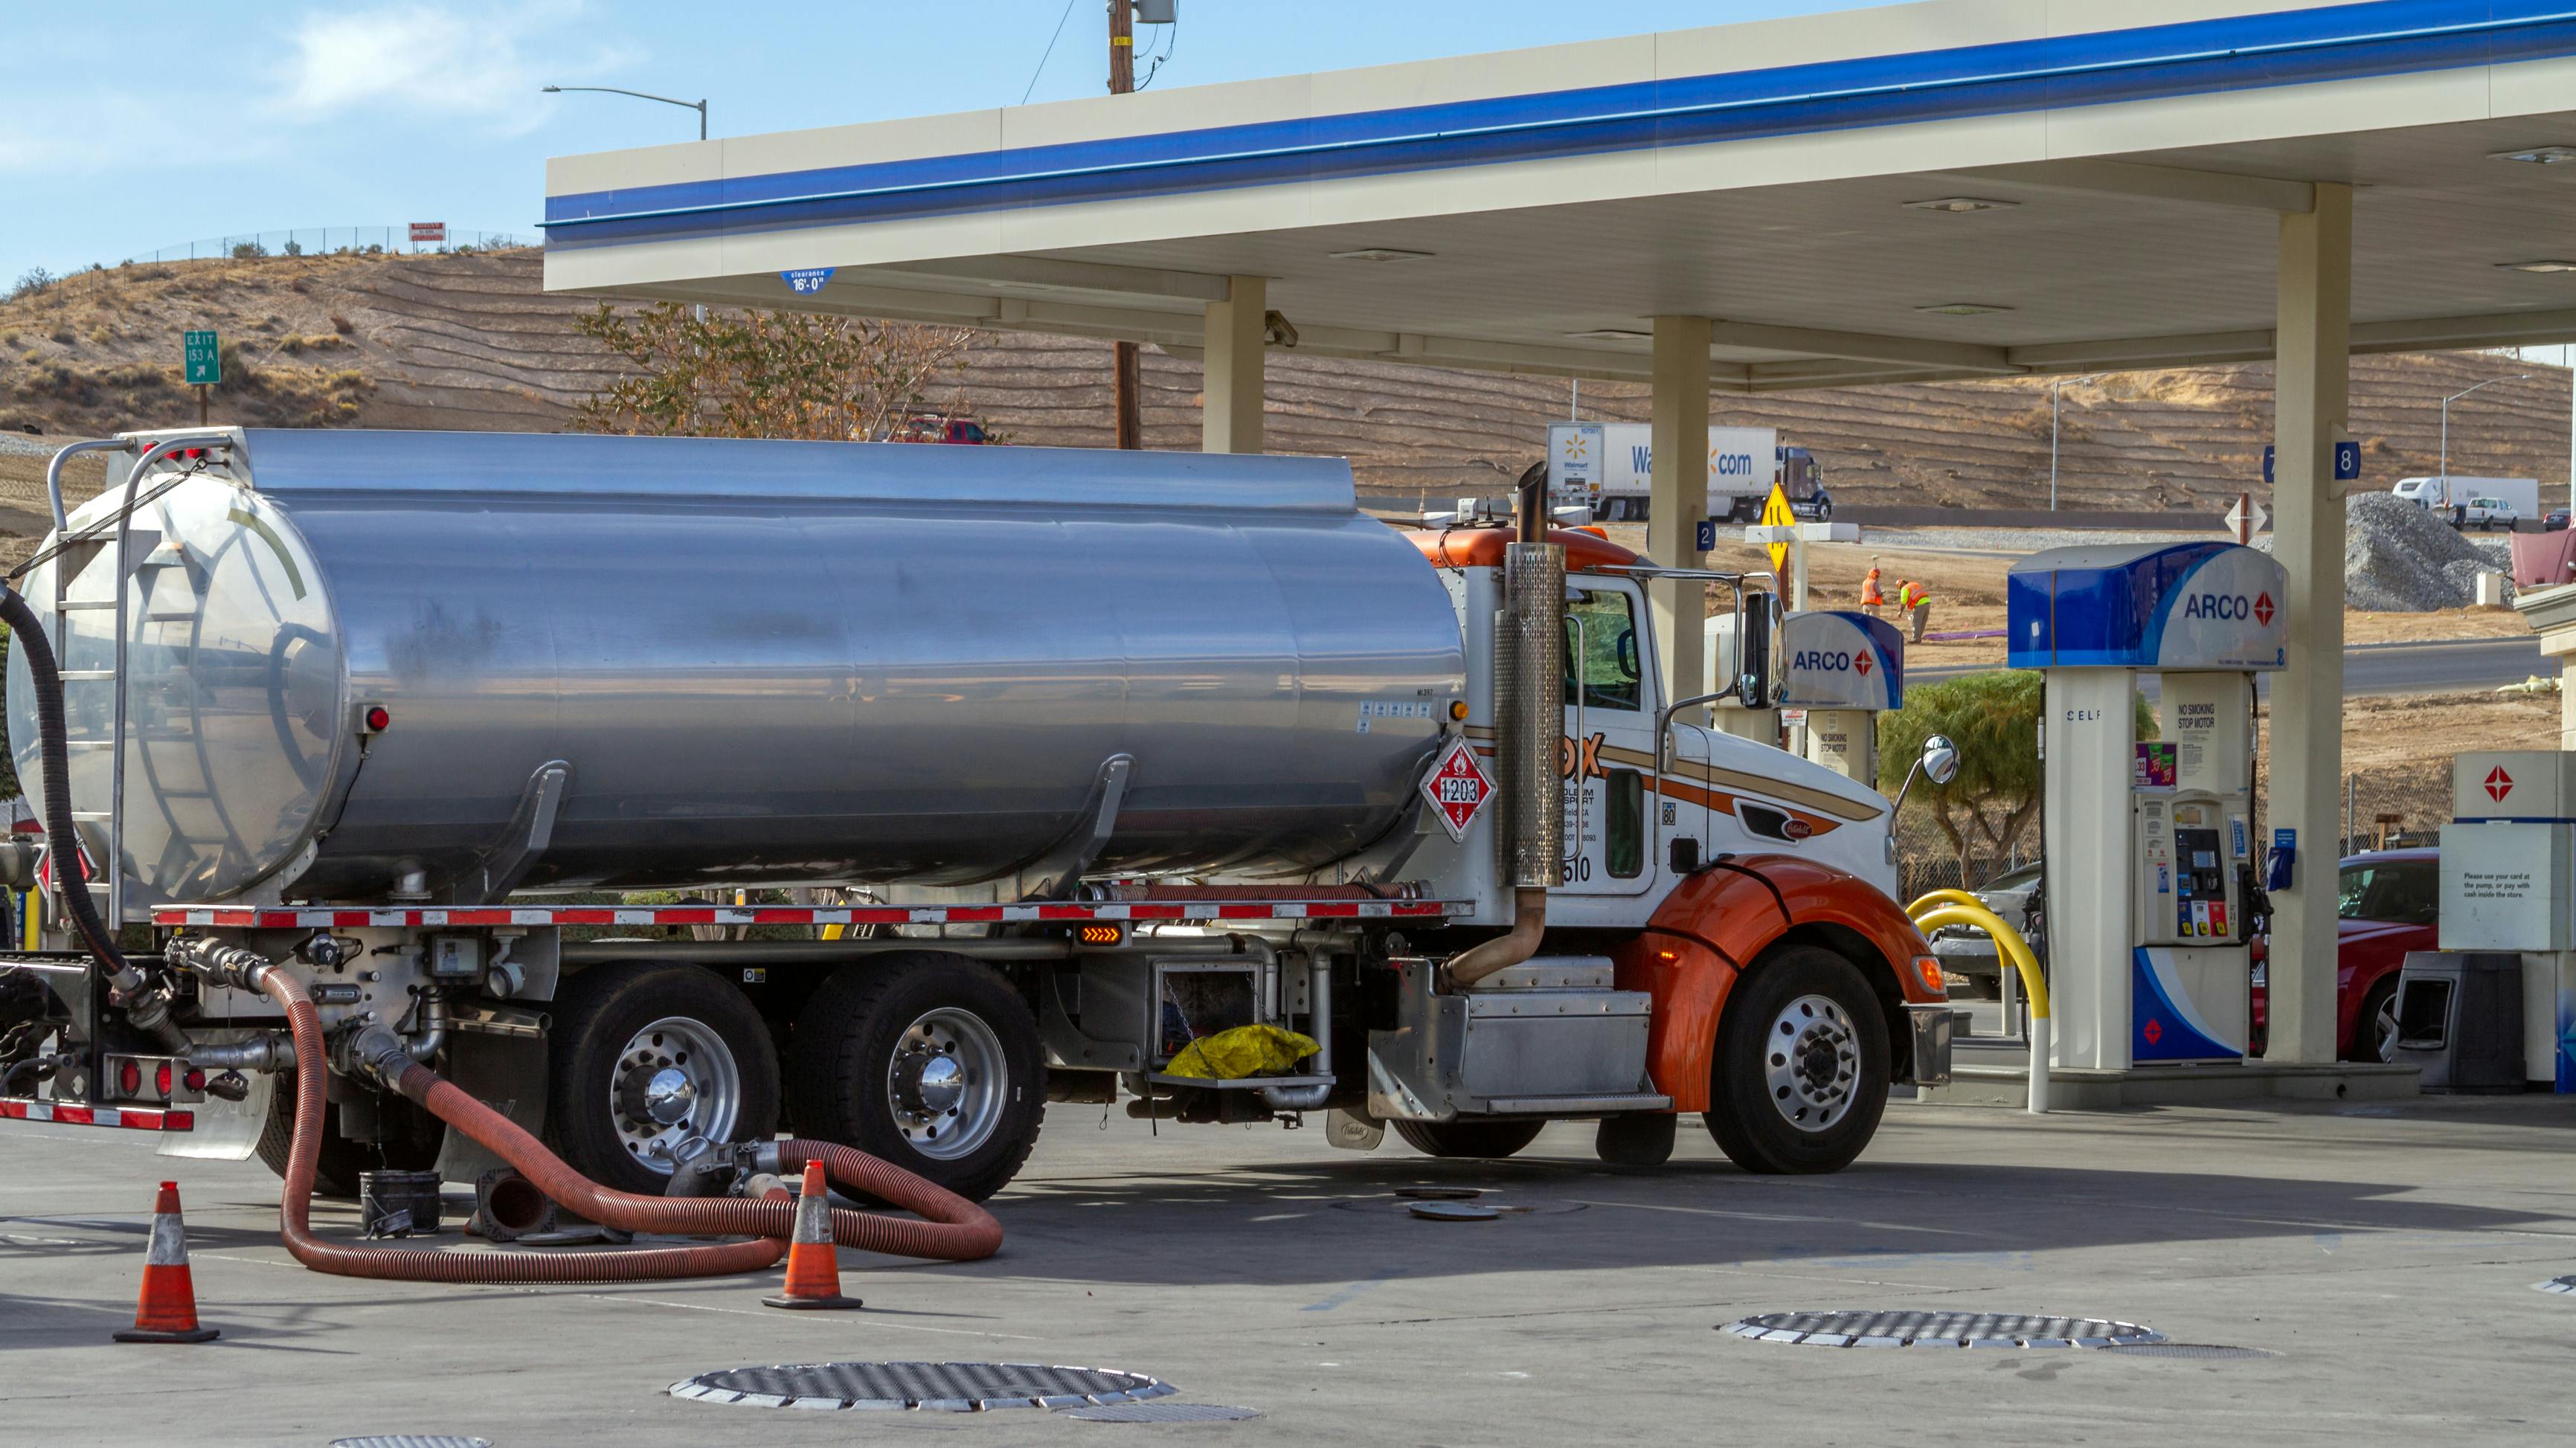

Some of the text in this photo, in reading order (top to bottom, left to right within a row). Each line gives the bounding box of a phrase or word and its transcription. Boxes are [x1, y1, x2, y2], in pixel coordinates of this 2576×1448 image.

[791, 270, 824, 278] clearance
[187, 335, 214, 346] EXIT
[188, 348, 215, 362] 153 A
[2341, 450, 2351, 471] 8
[1701, 528, 1709, 544] 2
[2184, 593, 2248, 620] ARCO
[1793, 651, 1849, 671] ARCO
[2277, 647, 2284, 666] 8
[2178, 703, 2214, 715] NO SMOKING
[2178, 717, 2214, 729] STOP MOTOR
[1821, 733, 1847, 742] NO SMOKING
[1821, 744, 1847, 753] STOP MOTOR
[1442, 779, 1477, 802] 1203
[1456, 811, 1462, 822] 3
[1663, 809, 1674, 823] 80
